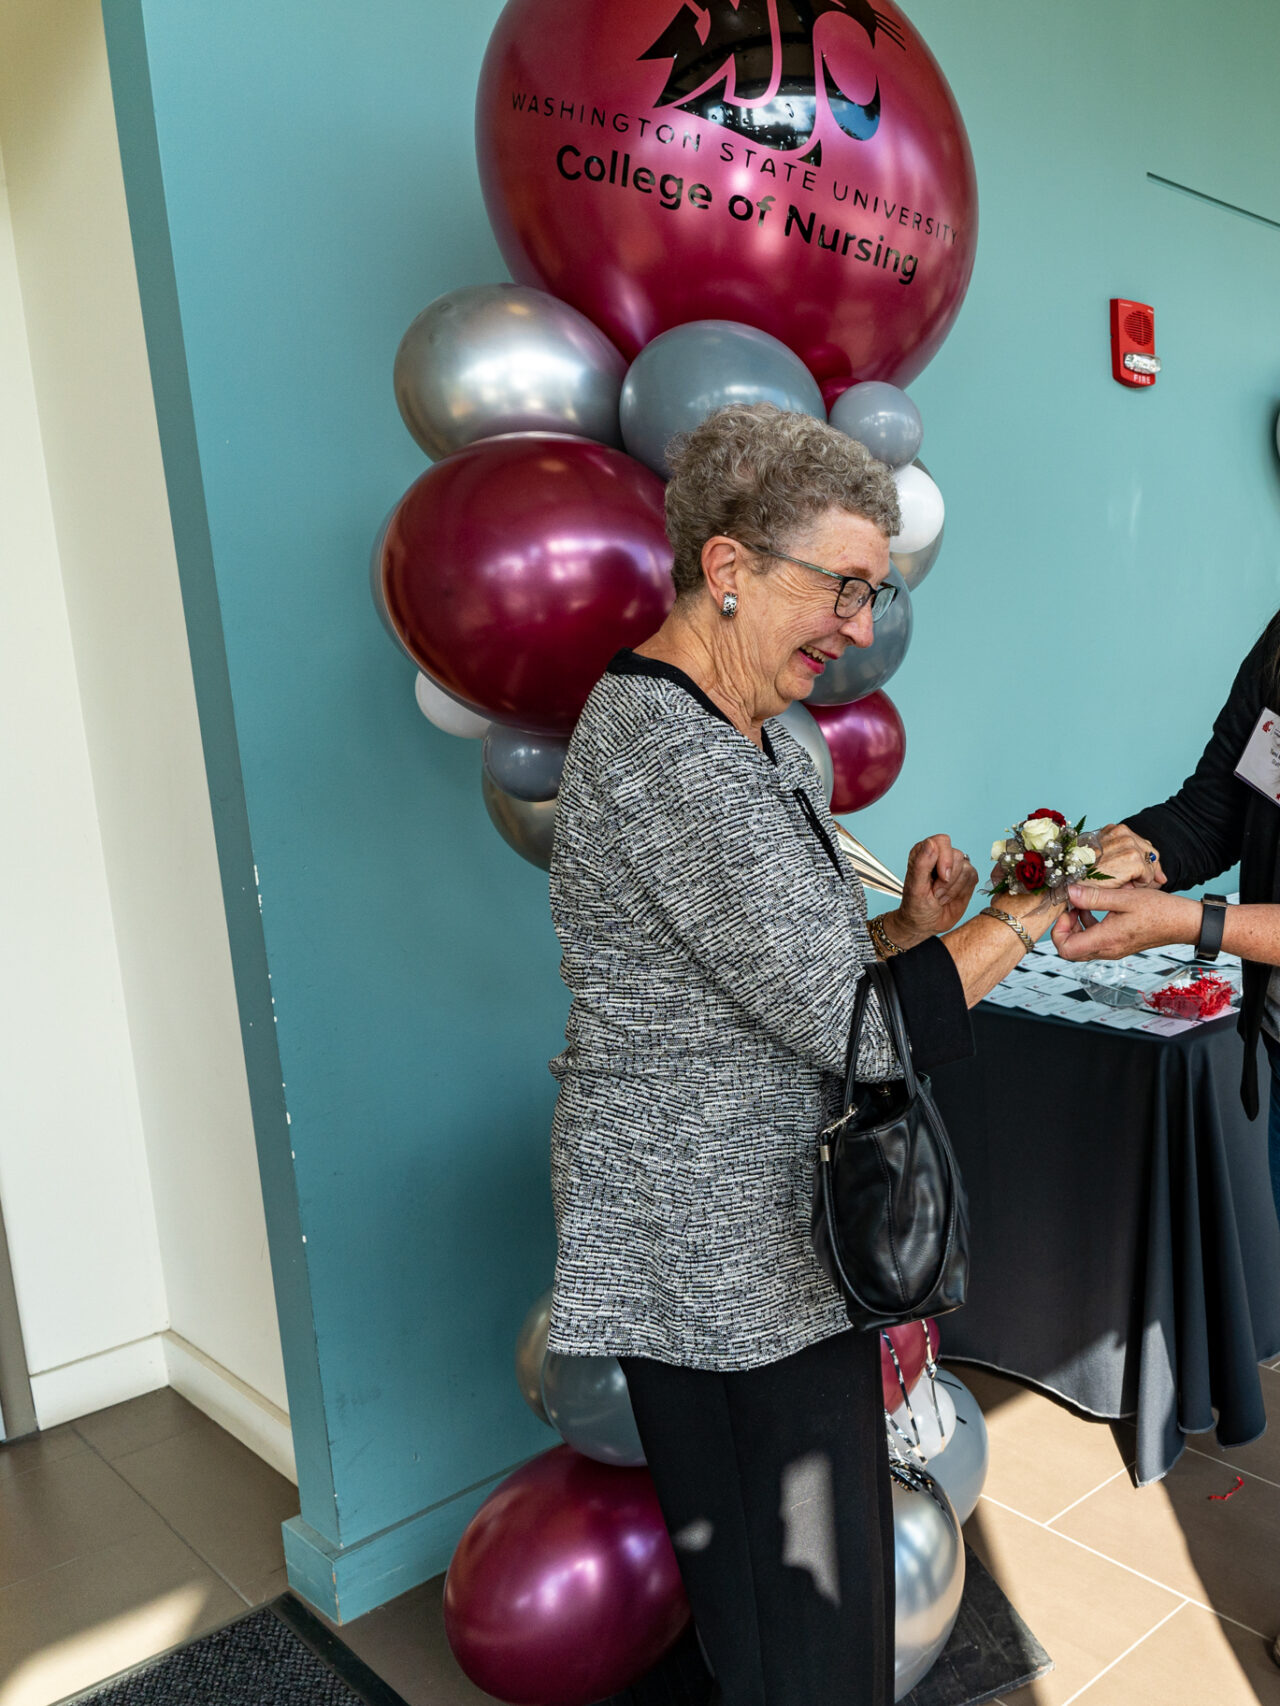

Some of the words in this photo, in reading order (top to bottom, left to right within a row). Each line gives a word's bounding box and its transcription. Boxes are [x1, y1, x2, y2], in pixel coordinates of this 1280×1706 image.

[511, 92, 701, 153] WASHINGTON
[719, 142, 817, 191] STATE
[833, 181, 959, 247] UNIVERSITY
[556, 144, 714, 211] College
[728, 194, 776, 228] of
[783, 204, 919, 286] Nursing
[1133, 374, 1151, 385] FIRE
